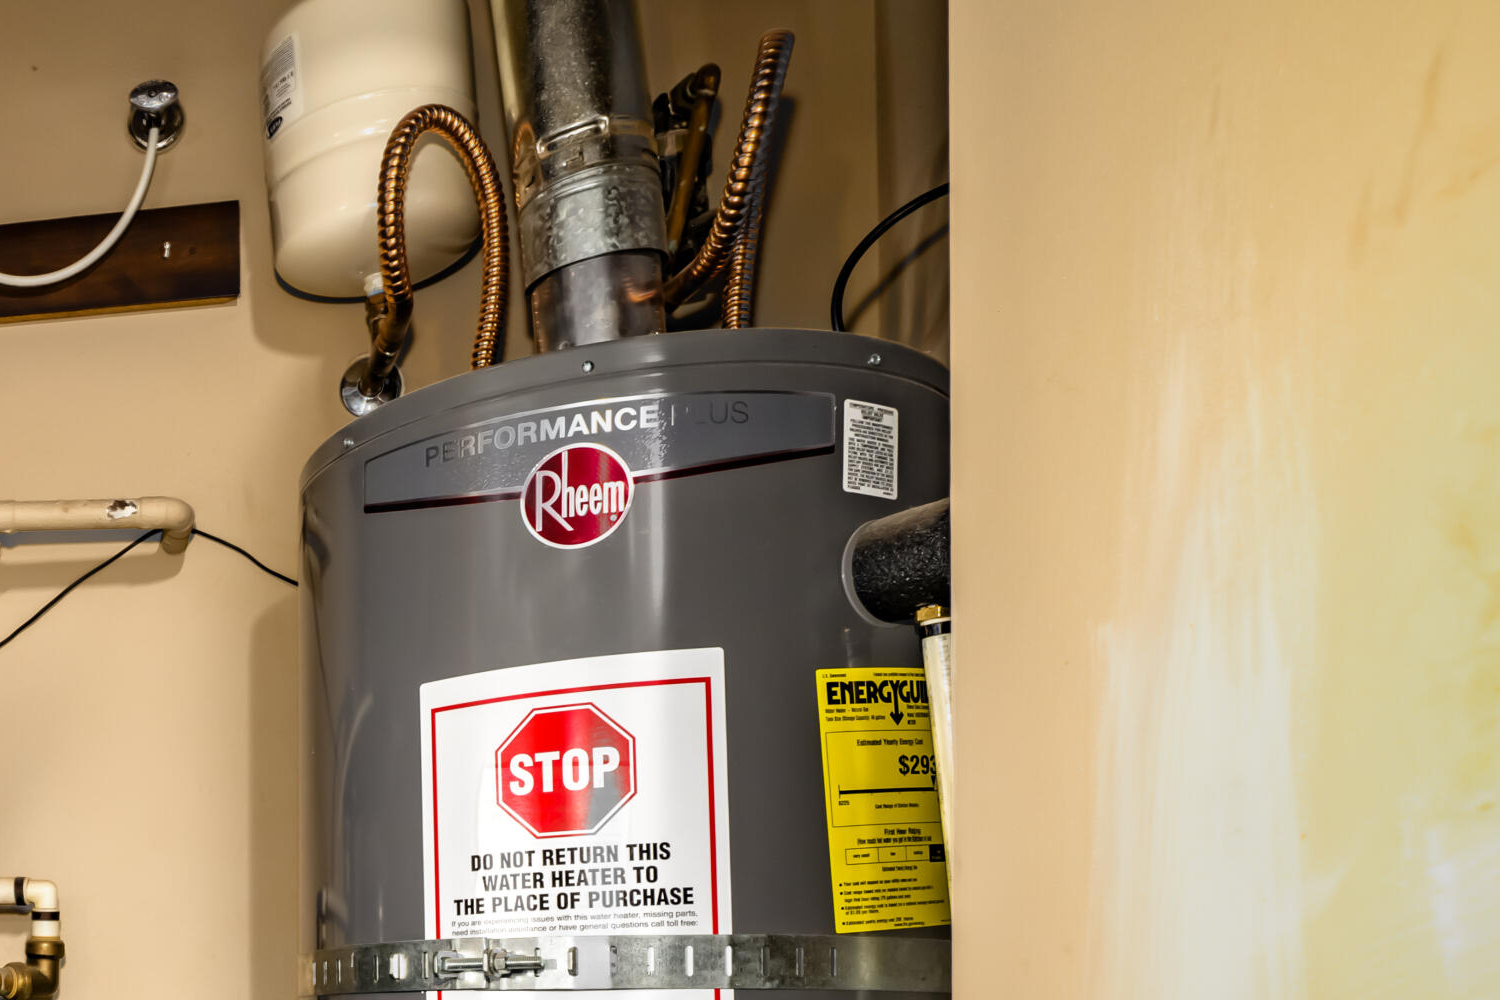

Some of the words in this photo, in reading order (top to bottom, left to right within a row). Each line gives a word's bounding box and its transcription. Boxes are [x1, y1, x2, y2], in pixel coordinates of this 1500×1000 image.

[425, 404, 660, 467] PERFORMANCE
[671, 398, 749, 426] US
[535, 450, 626, 532] Rheem
[826, 680, 929, 706] ENERGYGUI
[509, 746, 620, 796] STOP
[471, 854, 493, 872] DO
[500, 851, 535, 868] NOT
[542, 845, 619, 866] RETURN
[626, 842, 671, 861] THIS
[483, 872, 544, 892] WATER
[551, 867, 626, 888] HEATER
[633, 866, 658, 884] TO
[454, 898, 485, 916] THE
[492, 894, 550, 913] PLACE
[556, 892, 580, 910] OF
[588, 887, 694, 909] PURCHASE
[643, 910, 673, 919] missing
[675, 910, 698, 918] parts,
[580, 923, 608, 931] general
[610, 921, 649, 929] questions
[666, 919, 679, 927] toll
